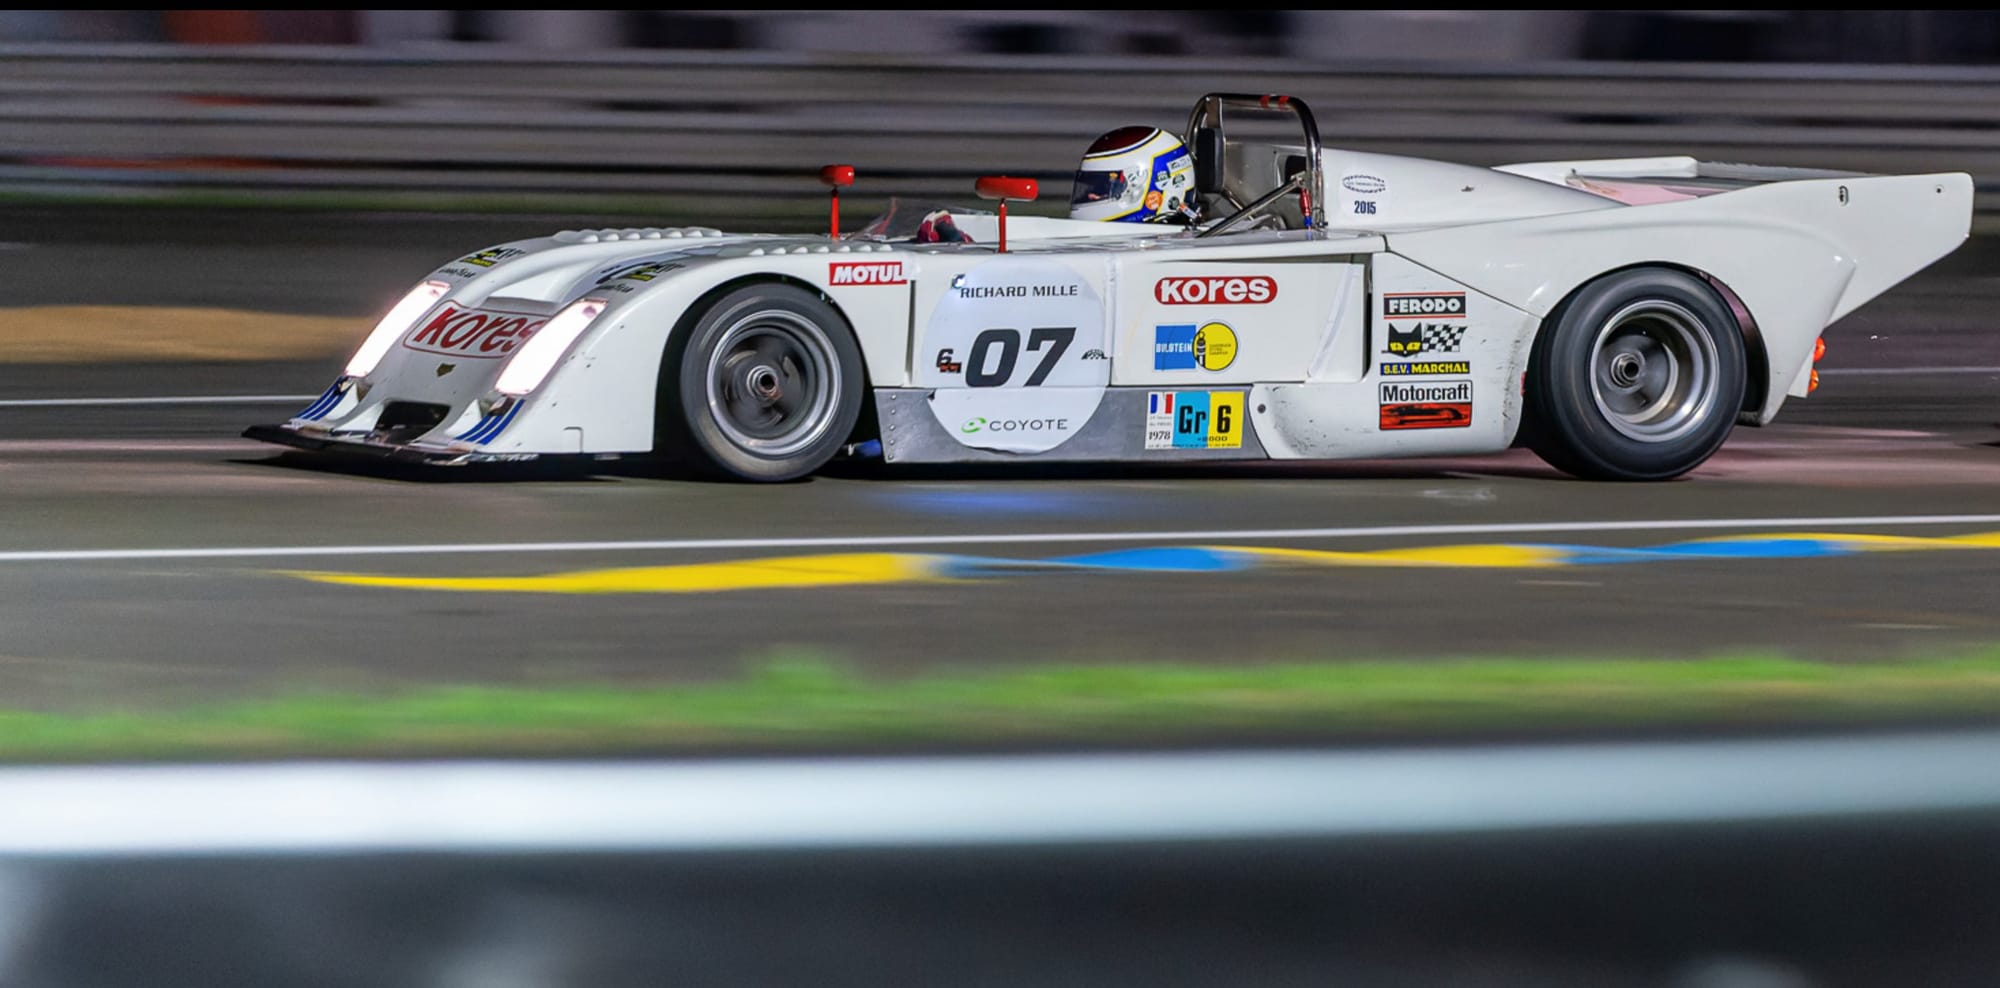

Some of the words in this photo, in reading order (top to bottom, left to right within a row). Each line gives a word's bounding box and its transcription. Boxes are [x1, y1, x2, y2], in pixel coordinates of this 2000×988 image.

[1354, 200, 1377, 215] 2015
[832, 264, 907, 284] MOTUL
[960, 286, 1027, 299] RICHARD
[1032, 285, 1078, 297] MILLE
[1388, 298, 1461, 314] FERODO
[965, 327, 1077, 388] 07
[1411, 363, 1469, 374] MARCHAL
[1383, 383, 1469, 402] Motorcraft
[989, 419, 1068, 431] COYOTE
[1178, 405, 1207, 434] Gr
[1216, 405, 1232, 434] 6
[1148, 431, 1171, 441] 1978
